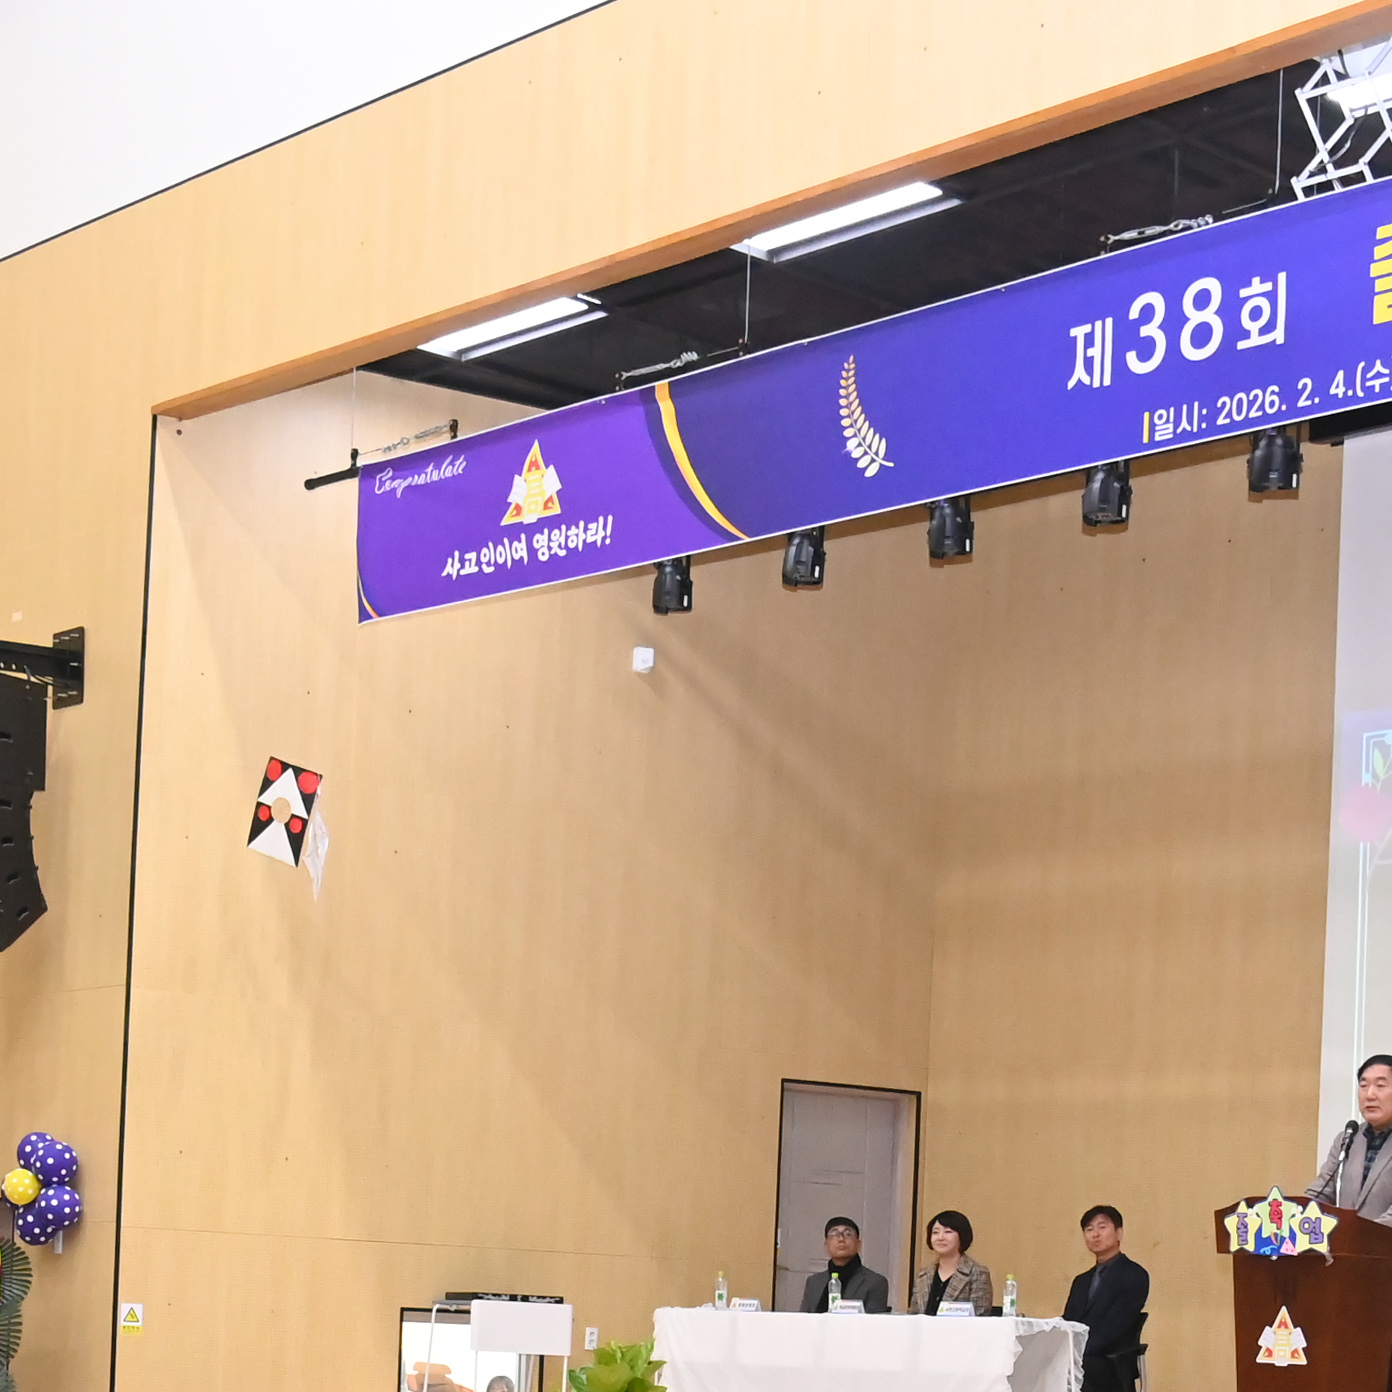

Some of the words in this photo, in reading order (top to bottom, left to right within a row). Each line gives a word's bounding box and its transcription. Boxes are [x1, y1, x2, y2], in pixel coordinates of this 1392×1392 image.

[1067, 271, 1287, 391] 제38회
[1153, 400, 1208, 442] 일시:
[1216, 384, 1287, 426] 2026.
[1296, 377, 1320, 408] 2.
[374, 454, 467, 498] Congratulate
[441, 532, 528, 581] 사고인이여
[532, 514, 614, 562] 영원하라!
